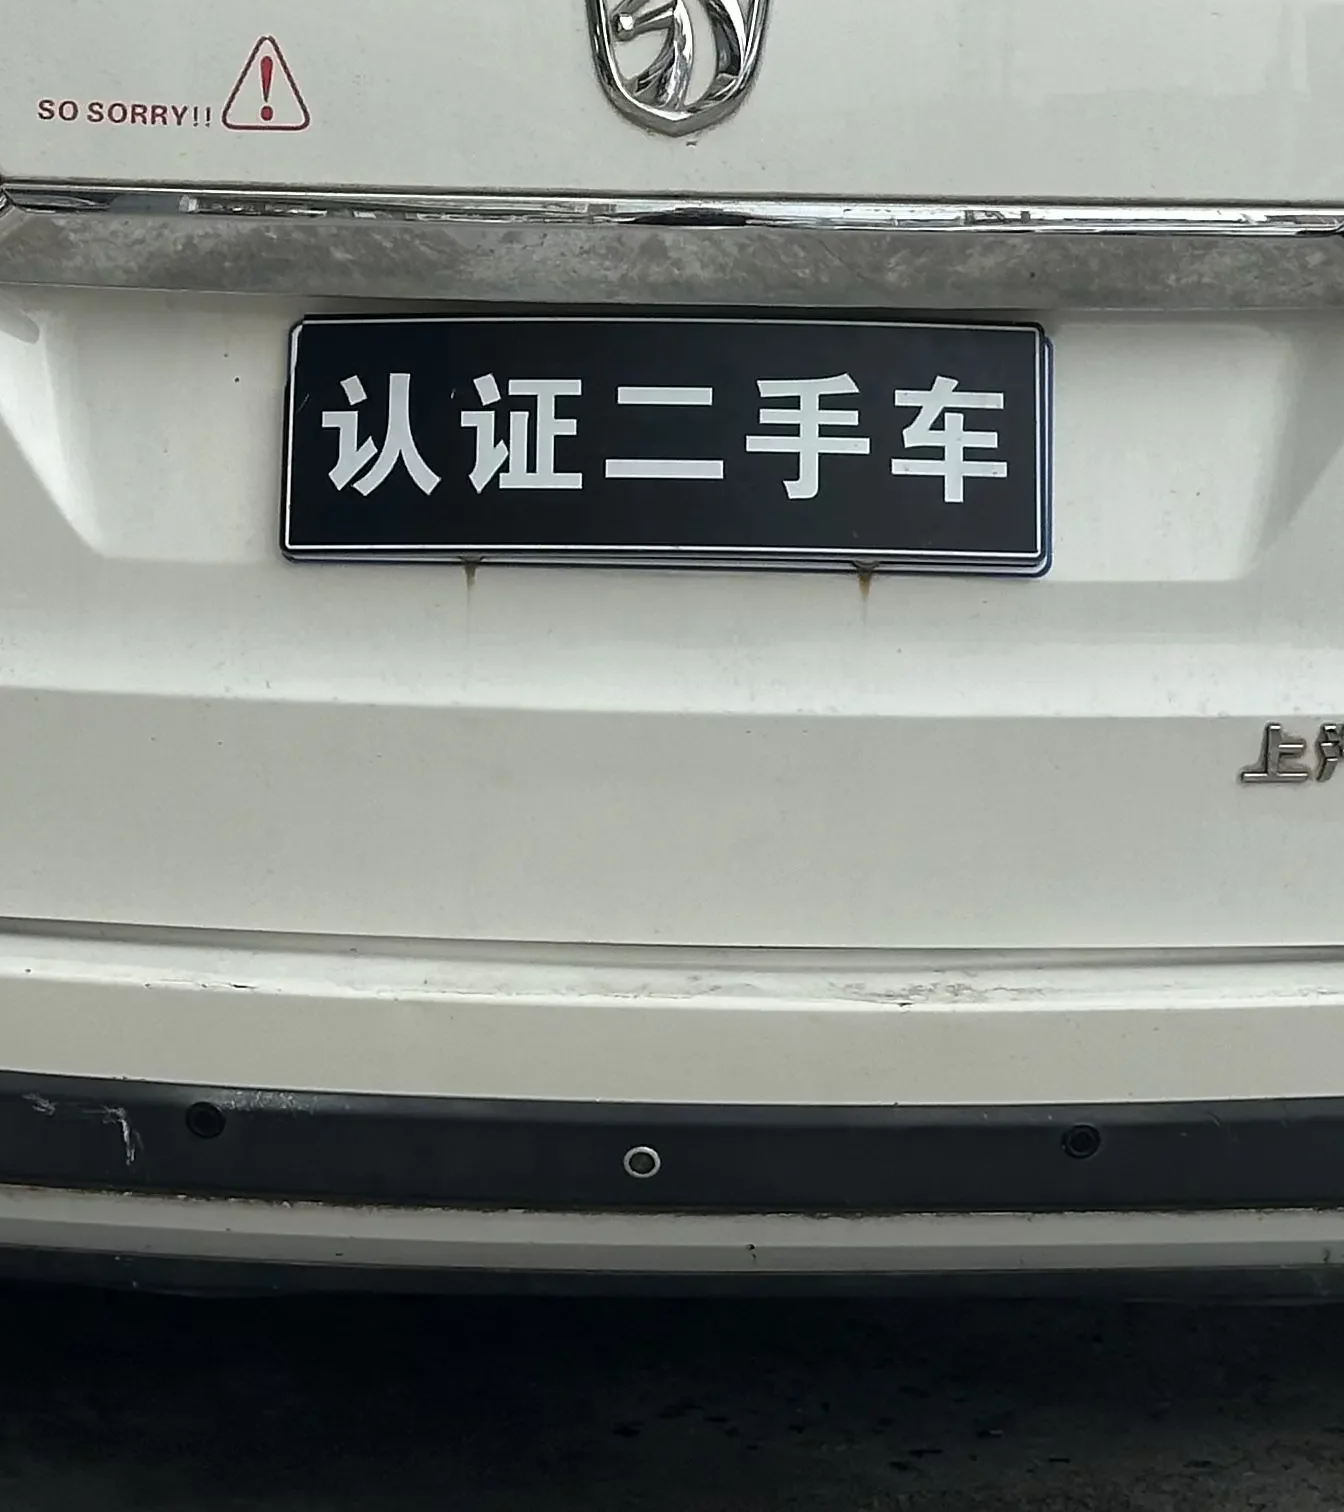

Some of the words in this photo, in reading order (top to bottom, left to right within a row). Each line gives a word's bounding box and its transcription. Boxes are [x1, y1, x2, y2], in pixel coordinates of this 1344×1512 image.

[37, 99, 79, 122] SO
[86, 101, 211, 128] SORRY!!
[322, 372, 1009, 503] 认证二手车
